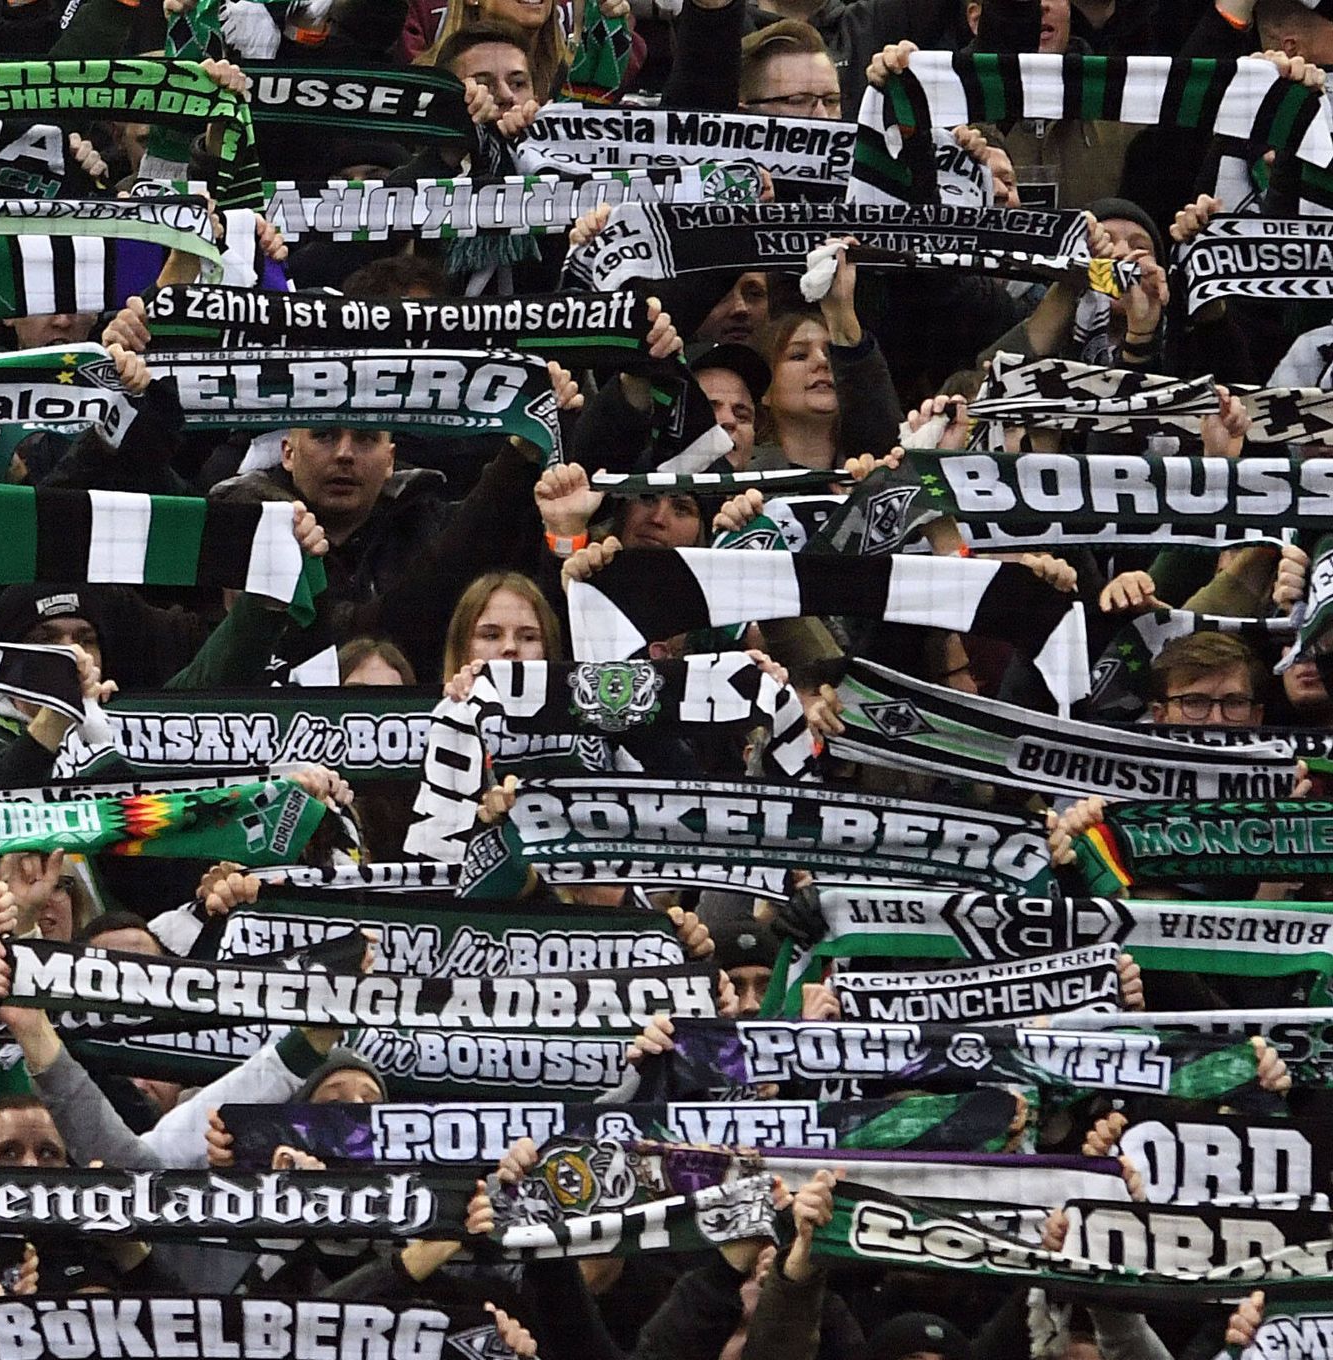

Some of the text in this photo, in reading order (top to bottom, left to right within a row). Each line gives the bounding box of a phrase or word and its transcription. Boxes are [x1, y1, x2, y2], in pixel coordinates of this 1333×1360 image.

[1263, 222, 1299, 235] DIE
[283, 300, 327, 328] ist
[342, 300, 391, 331] die
[404, 289, 637, 332] Freundschaft
[1016, 740, 1198, 800] BORUSSIA
[514, 794, 1052, 882] BÖKELBERG
[848, 898, 1332, 944] SEIT BORUSSIA
[12, 942, 719, 1028] MÖNCHENGLADBACH
[924, 971, 979, 985] VOM
